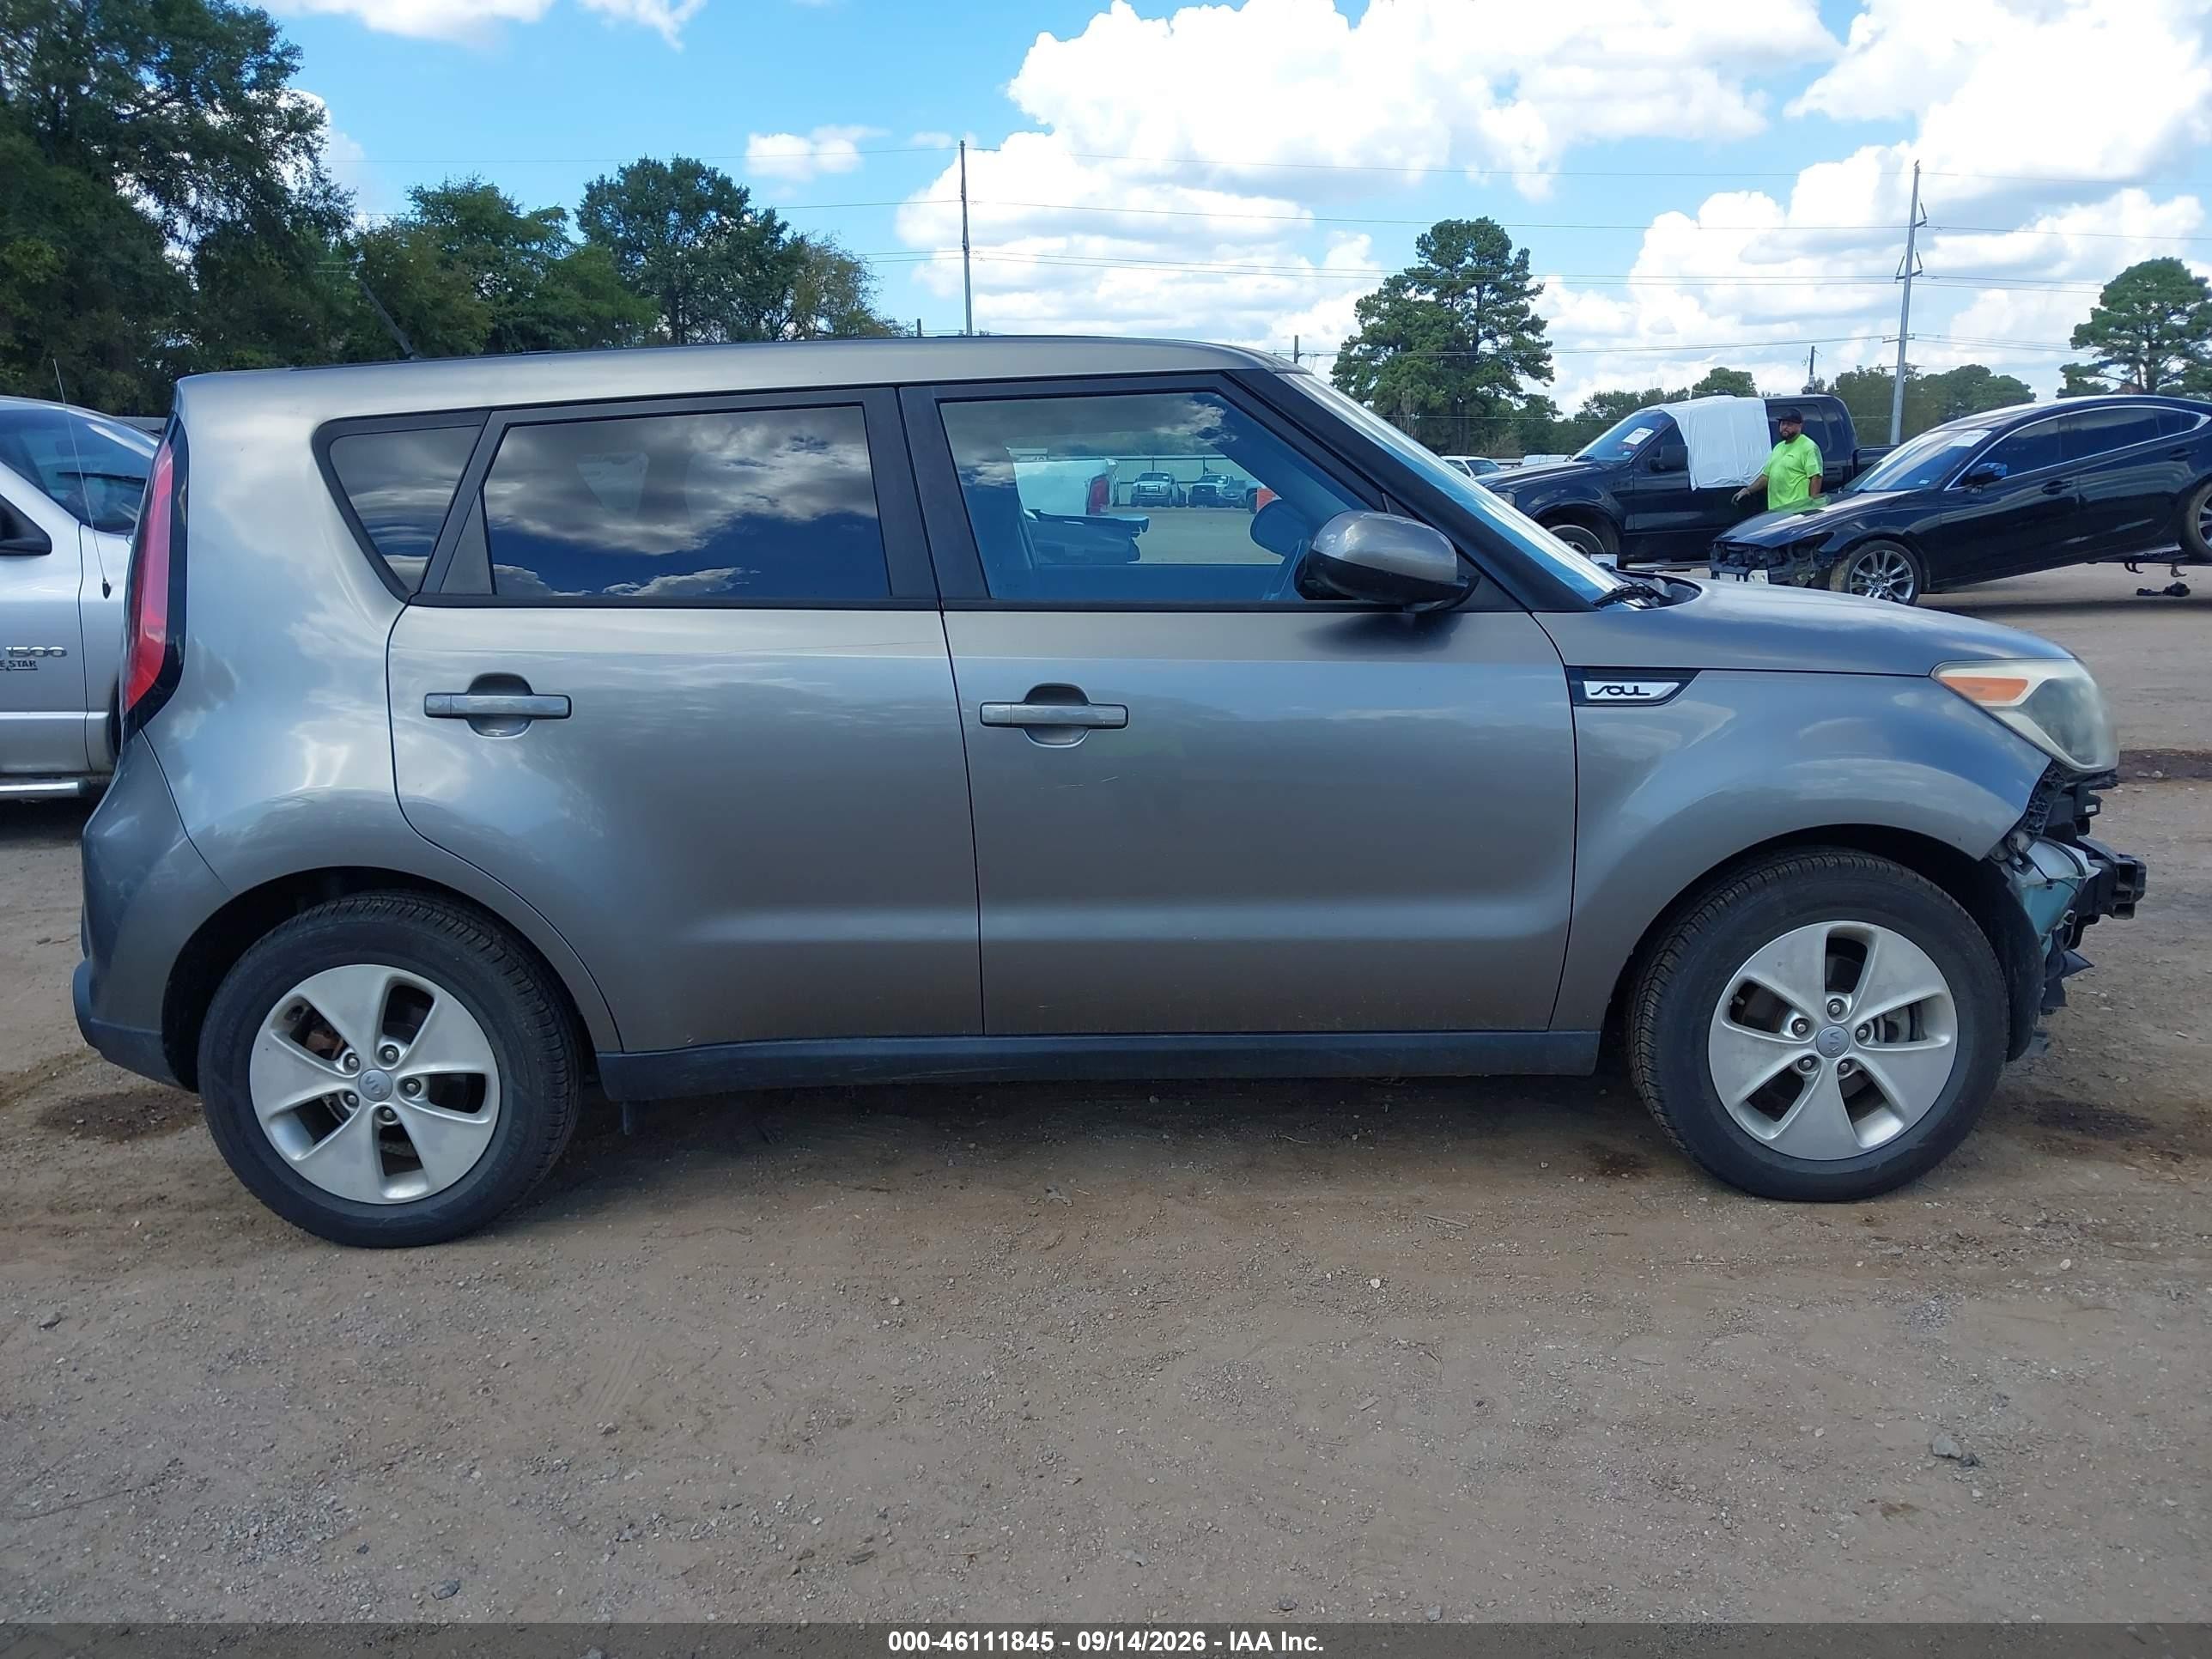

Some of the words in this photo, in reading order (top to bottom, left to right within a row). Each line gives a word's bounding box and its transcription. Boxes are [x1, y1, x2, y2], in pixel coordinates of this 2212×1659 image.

[5, 646, 67, 658] 1500
[8, 659, 37, 668] STAR
[1590, 685, 1650, 696] SOUL
